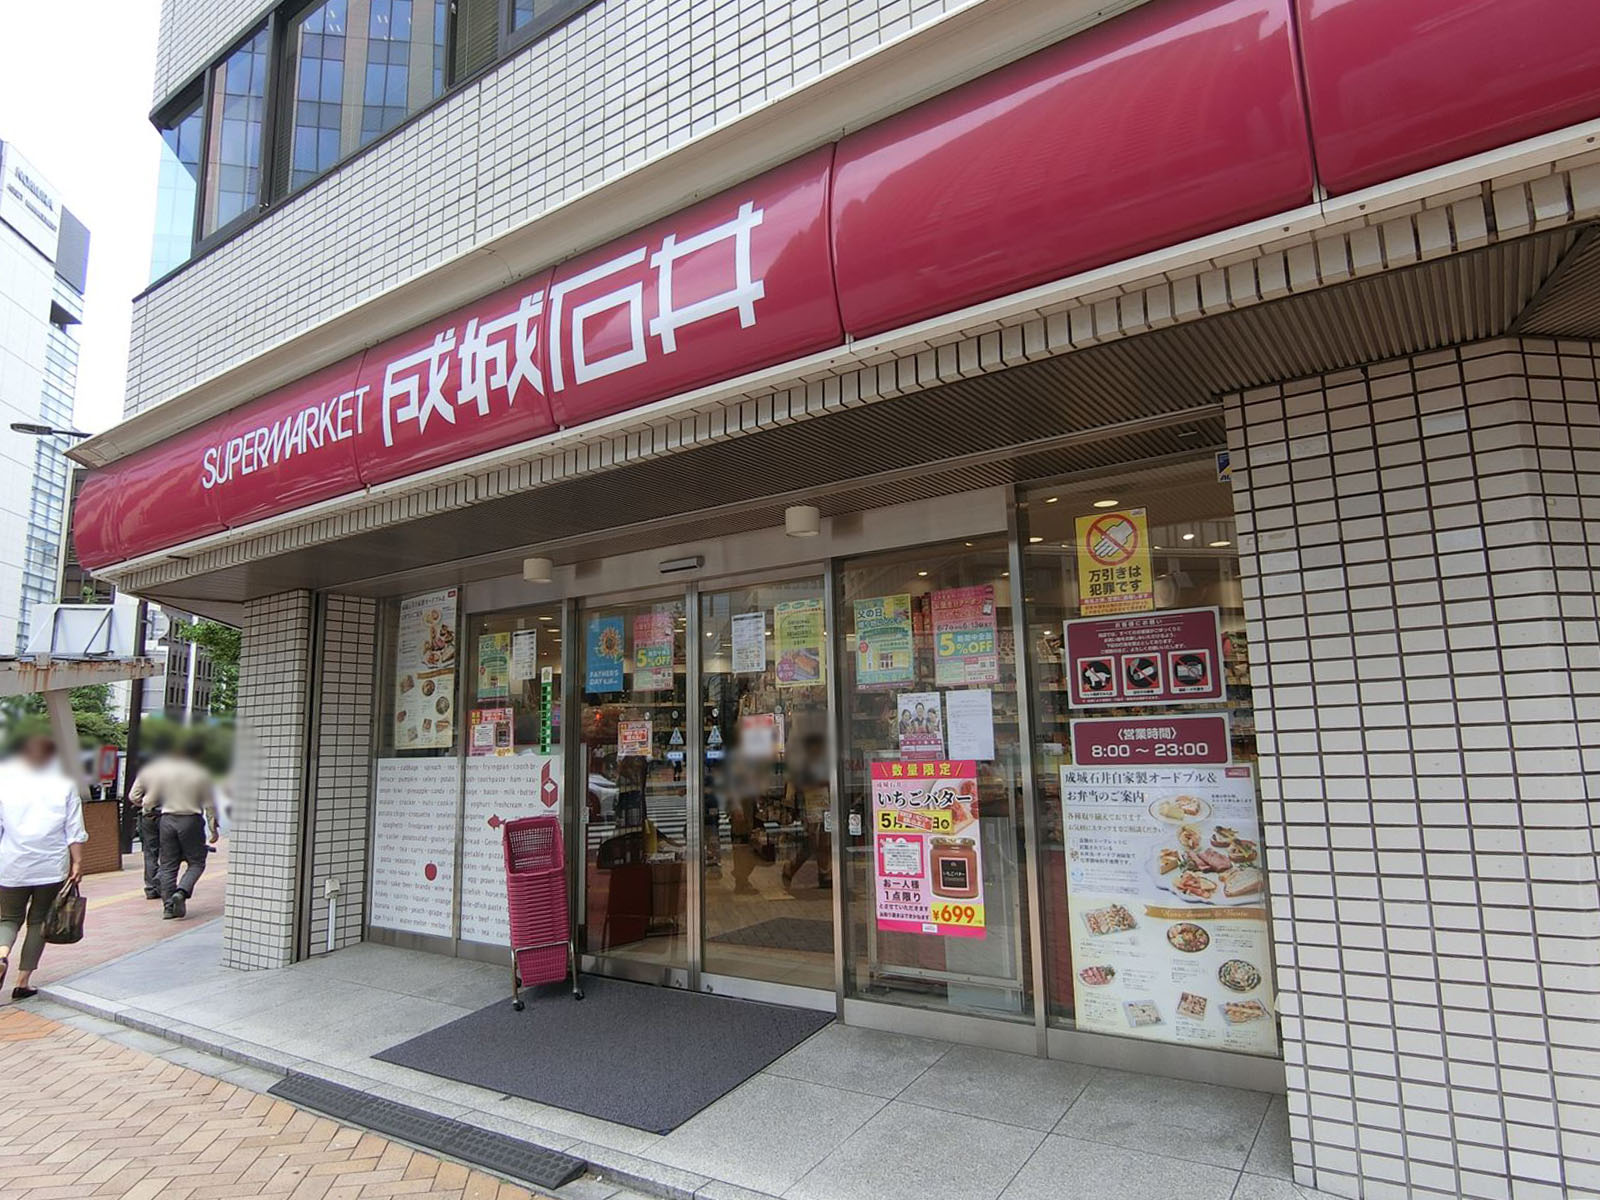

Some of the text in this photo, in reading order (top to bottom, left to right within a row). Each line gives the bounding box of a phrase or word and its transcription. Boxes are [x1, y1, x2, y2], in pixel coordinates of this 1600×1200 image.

[381, 200, 766, 448] 成城石井
[201, 383, 370, 490] SUPERMARKET
[1088, 565, 1142, 582] 万引きは
[1089, 580, 1142, 596] 犯罪です
[892, 763, 952, 776] 数量限定
[878, 790, 972, 807] いちごバター
[1067, 790, 1145, 804] お弁当のご案内
[884, 879, 920, 889] お一人様
[884, 891, 921, 902] 1点限り
[933, 905, 974, 924] ¥699
